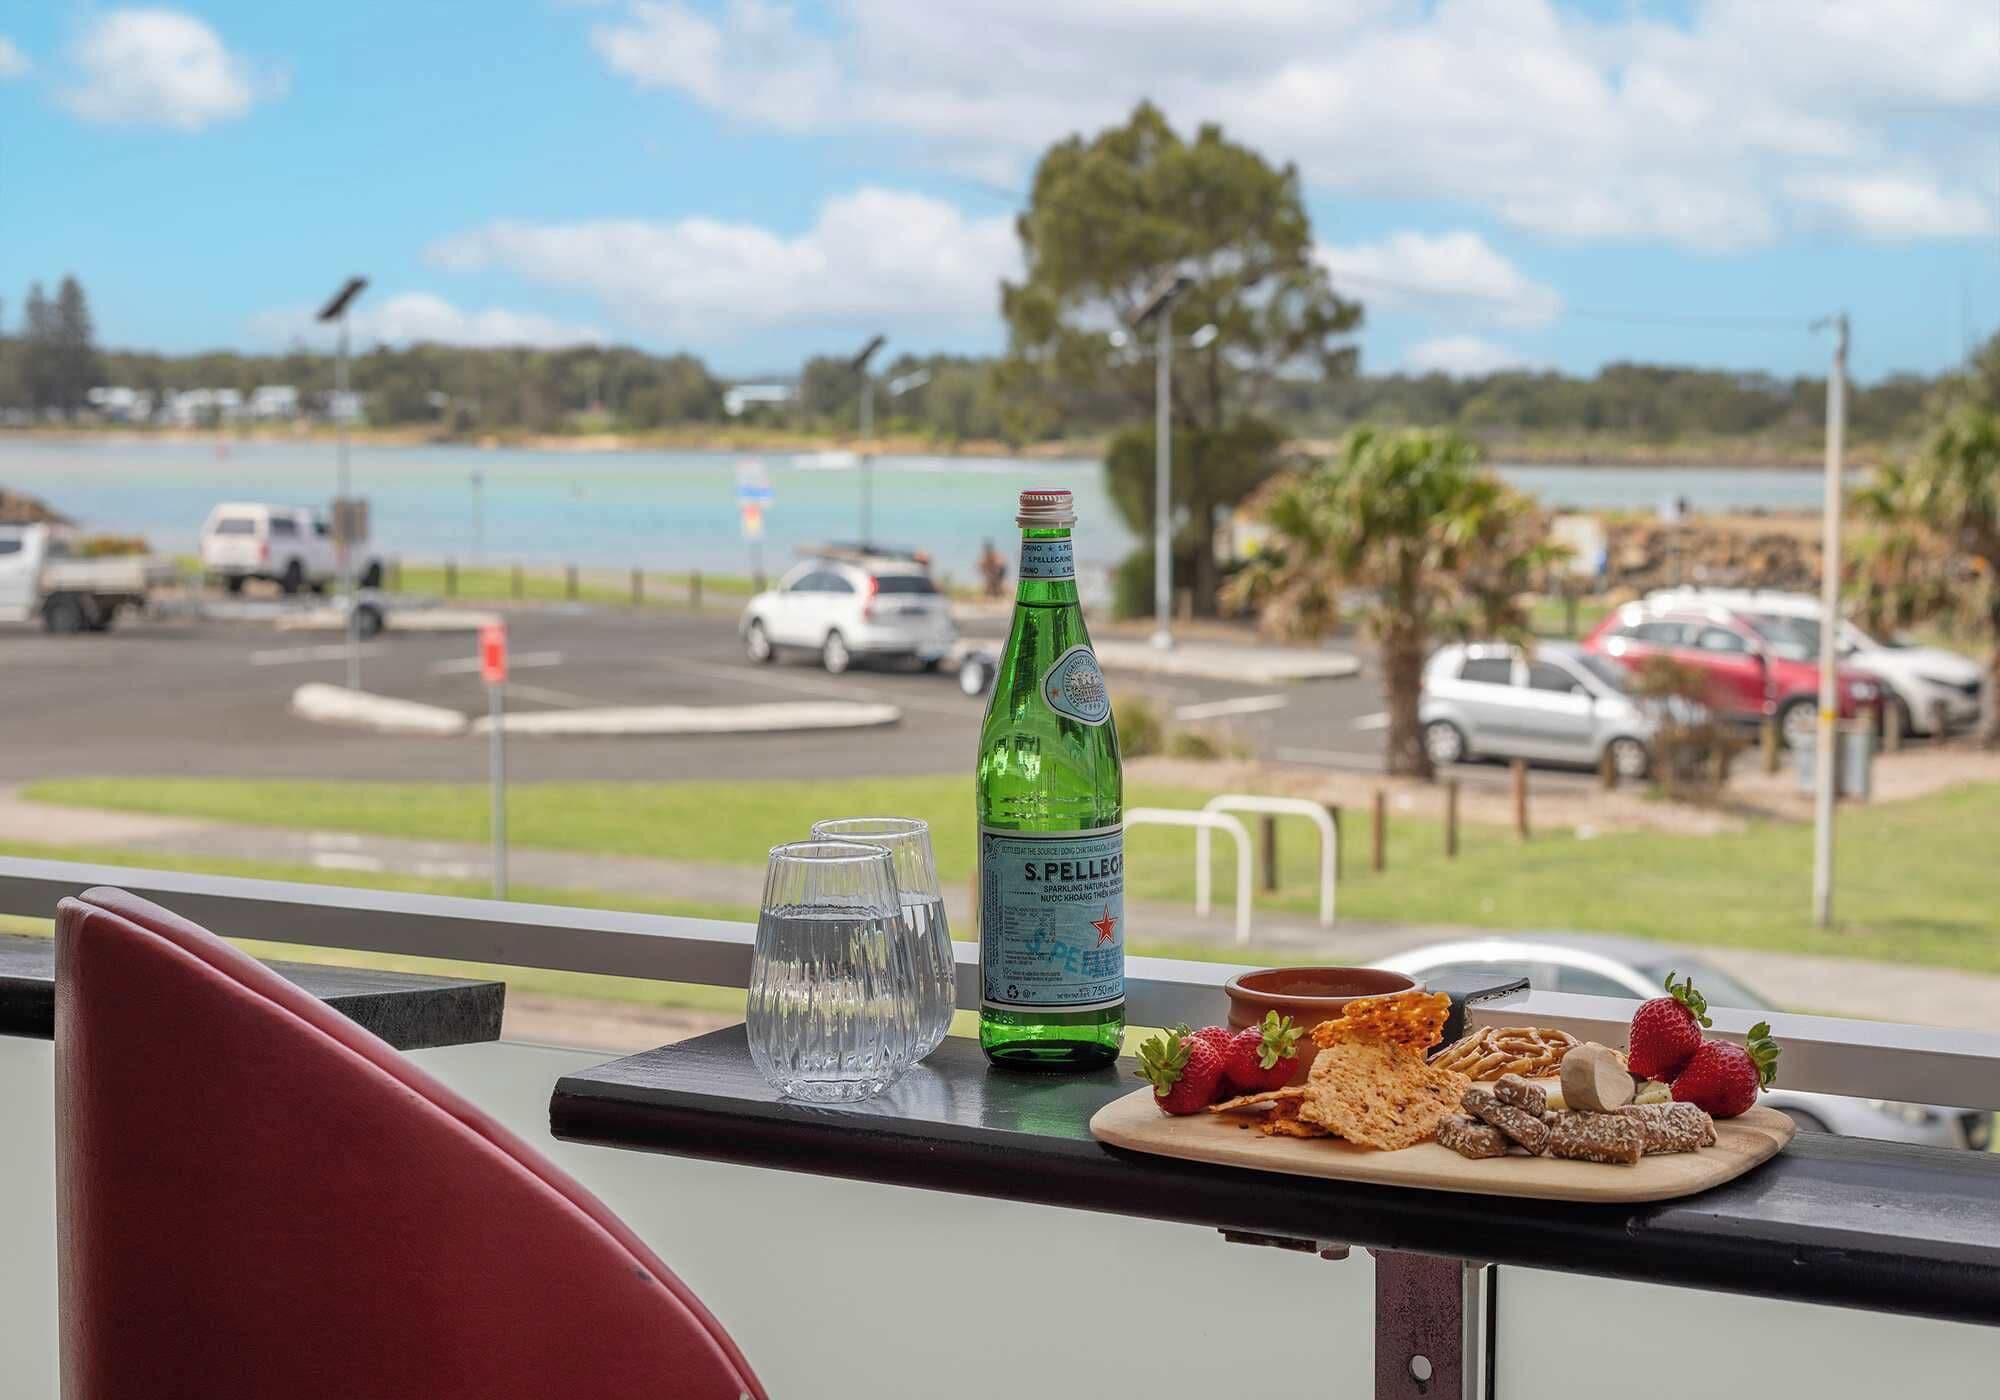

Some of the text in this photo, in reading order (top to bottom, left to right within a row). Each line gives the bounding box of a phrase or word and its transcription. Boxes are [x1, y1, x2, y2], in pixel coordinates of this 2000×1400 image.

[1036, 847, 1058, 856] SOURCE
[1043, 883, 1083, 893] SPARKLING
[1084, 880, 1110, 891] NATURAL
[1092, 985, 1107, 997] 750
